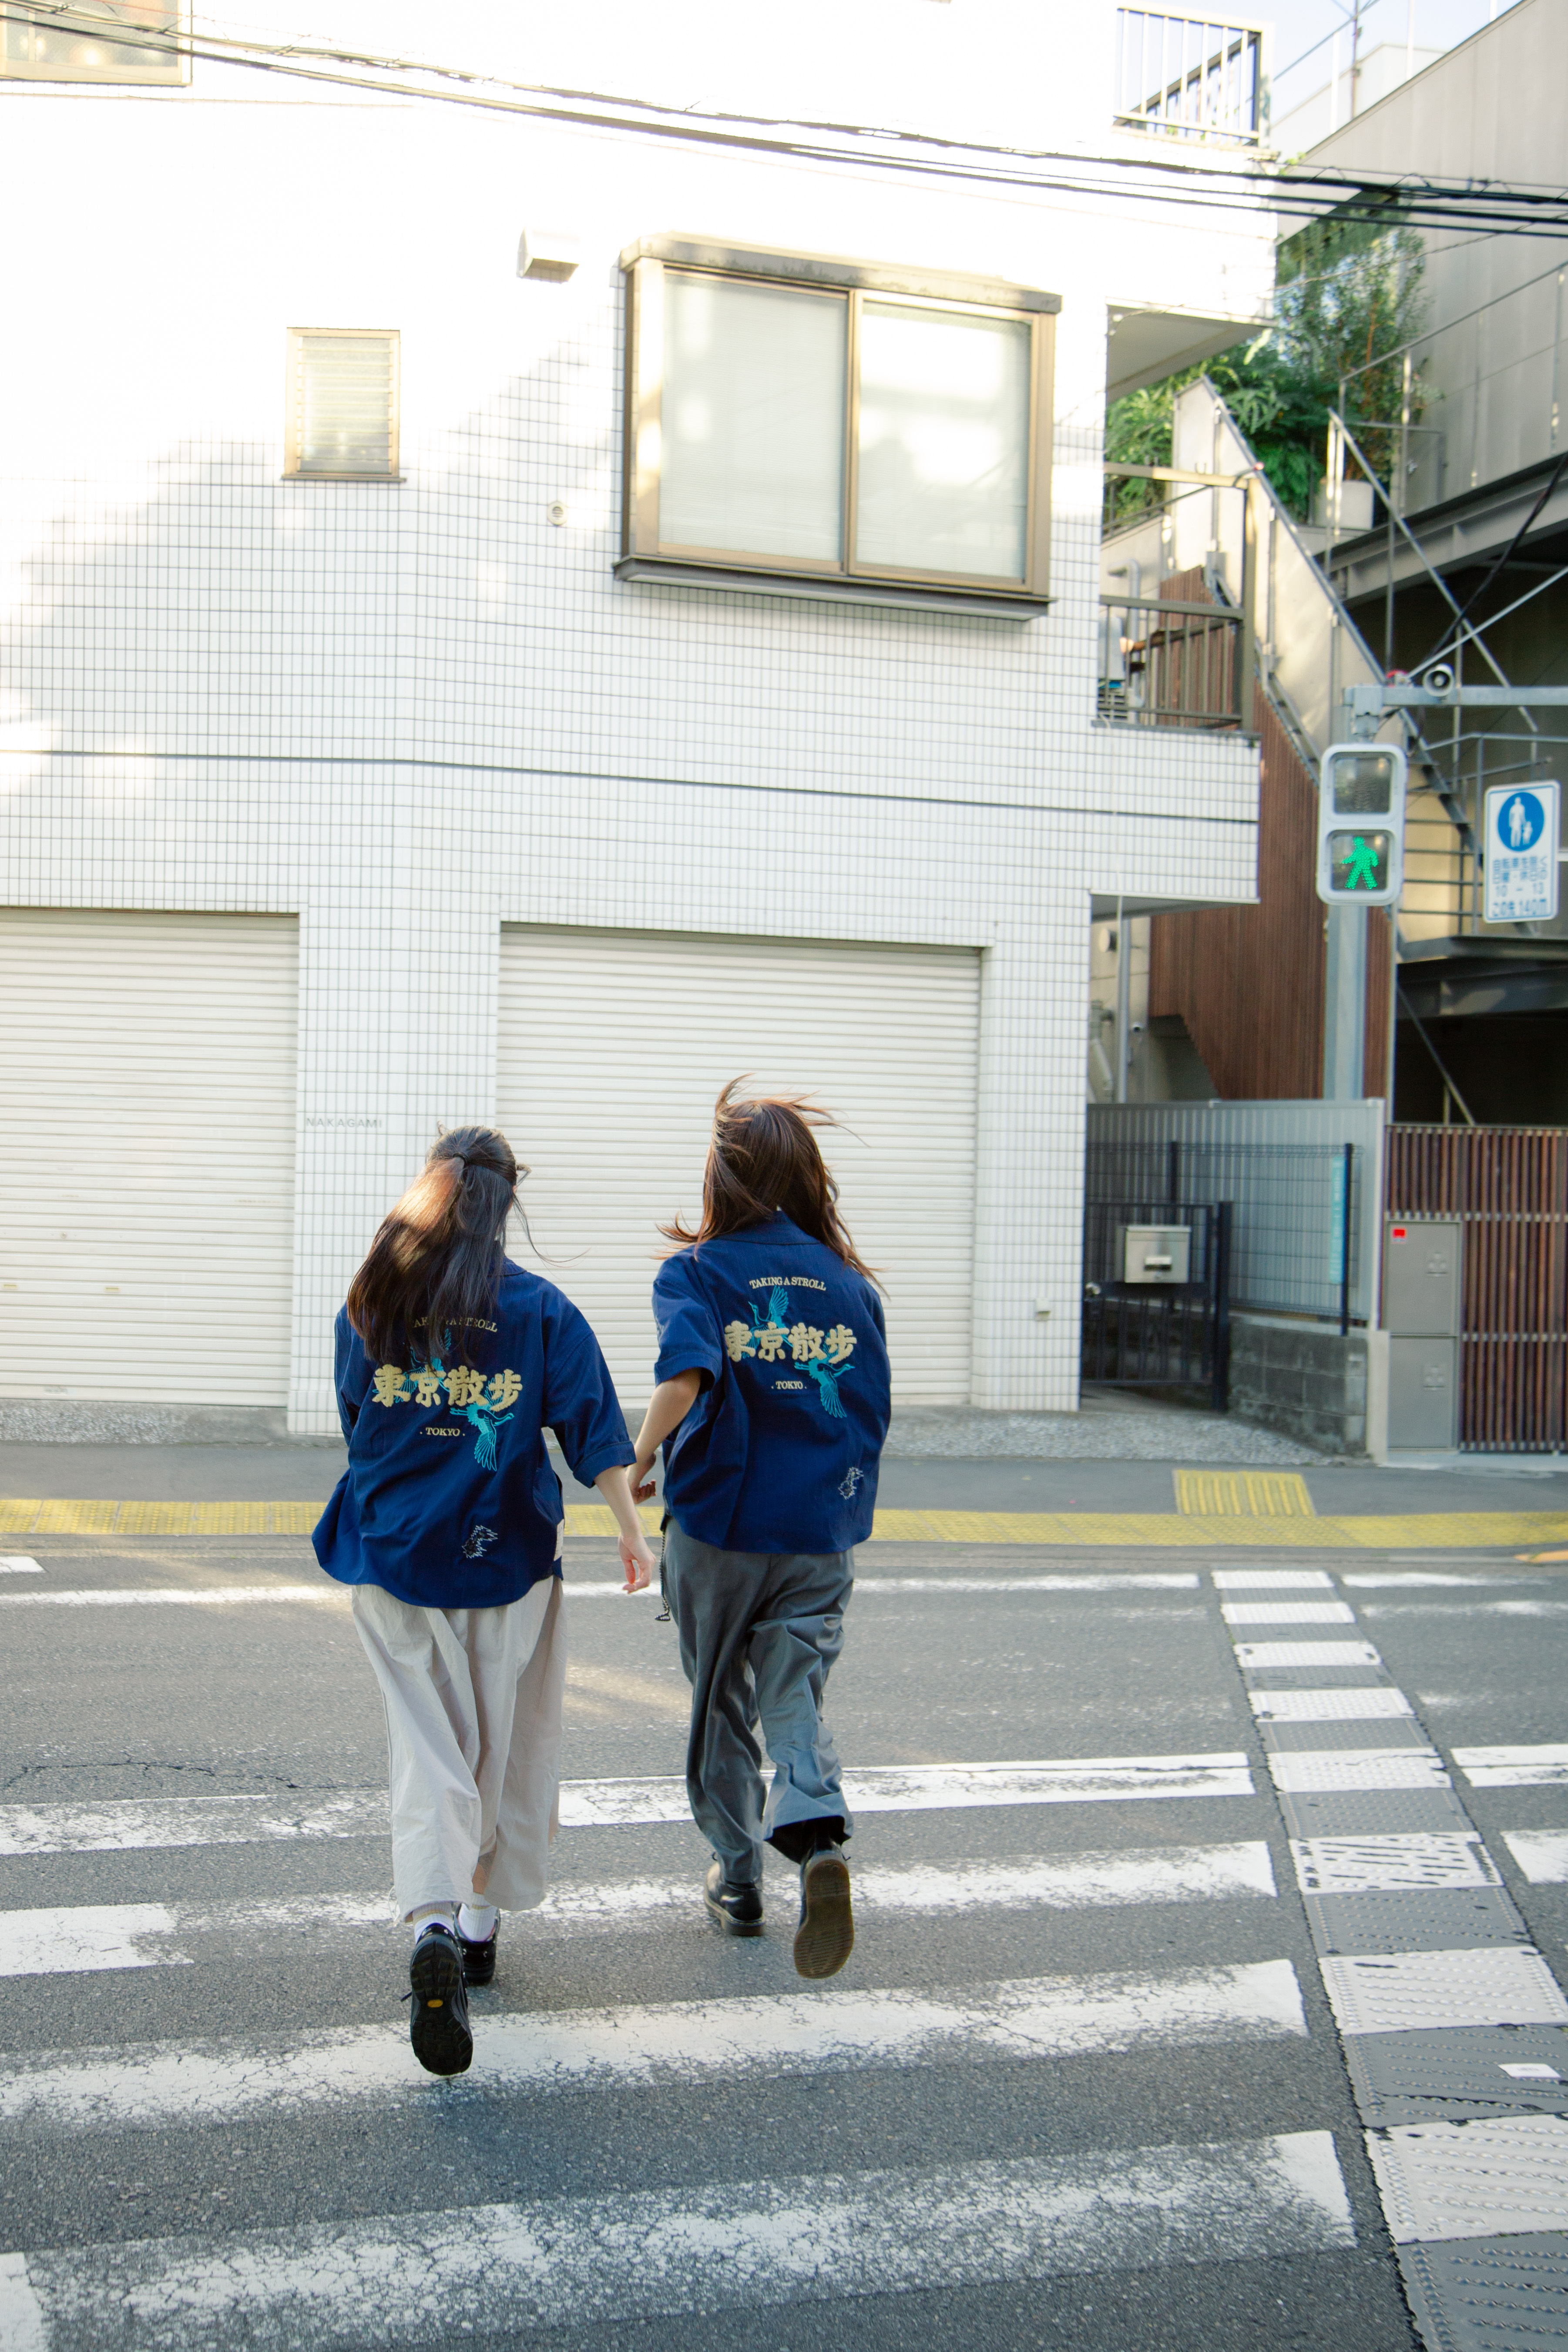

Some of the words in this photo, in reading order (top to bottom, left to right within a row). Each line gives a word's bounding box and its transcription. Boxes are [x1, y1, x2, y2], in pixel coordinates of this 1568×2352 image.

[306, 1118, 382, 1128] NAKAGAMI
[749, 1277, 782, 1289] TAKING
[783, 1277, 790, 1285] A
[791, 1277, 826, 1291] STROLL
[724, 1320, 857, 1364] 東京散歩
[372, 1364, 523, 1412] 東京散歩
[776, 1381, 803, 1389] TOKYO
[426, 1427, 461, 1437] TOKYO
